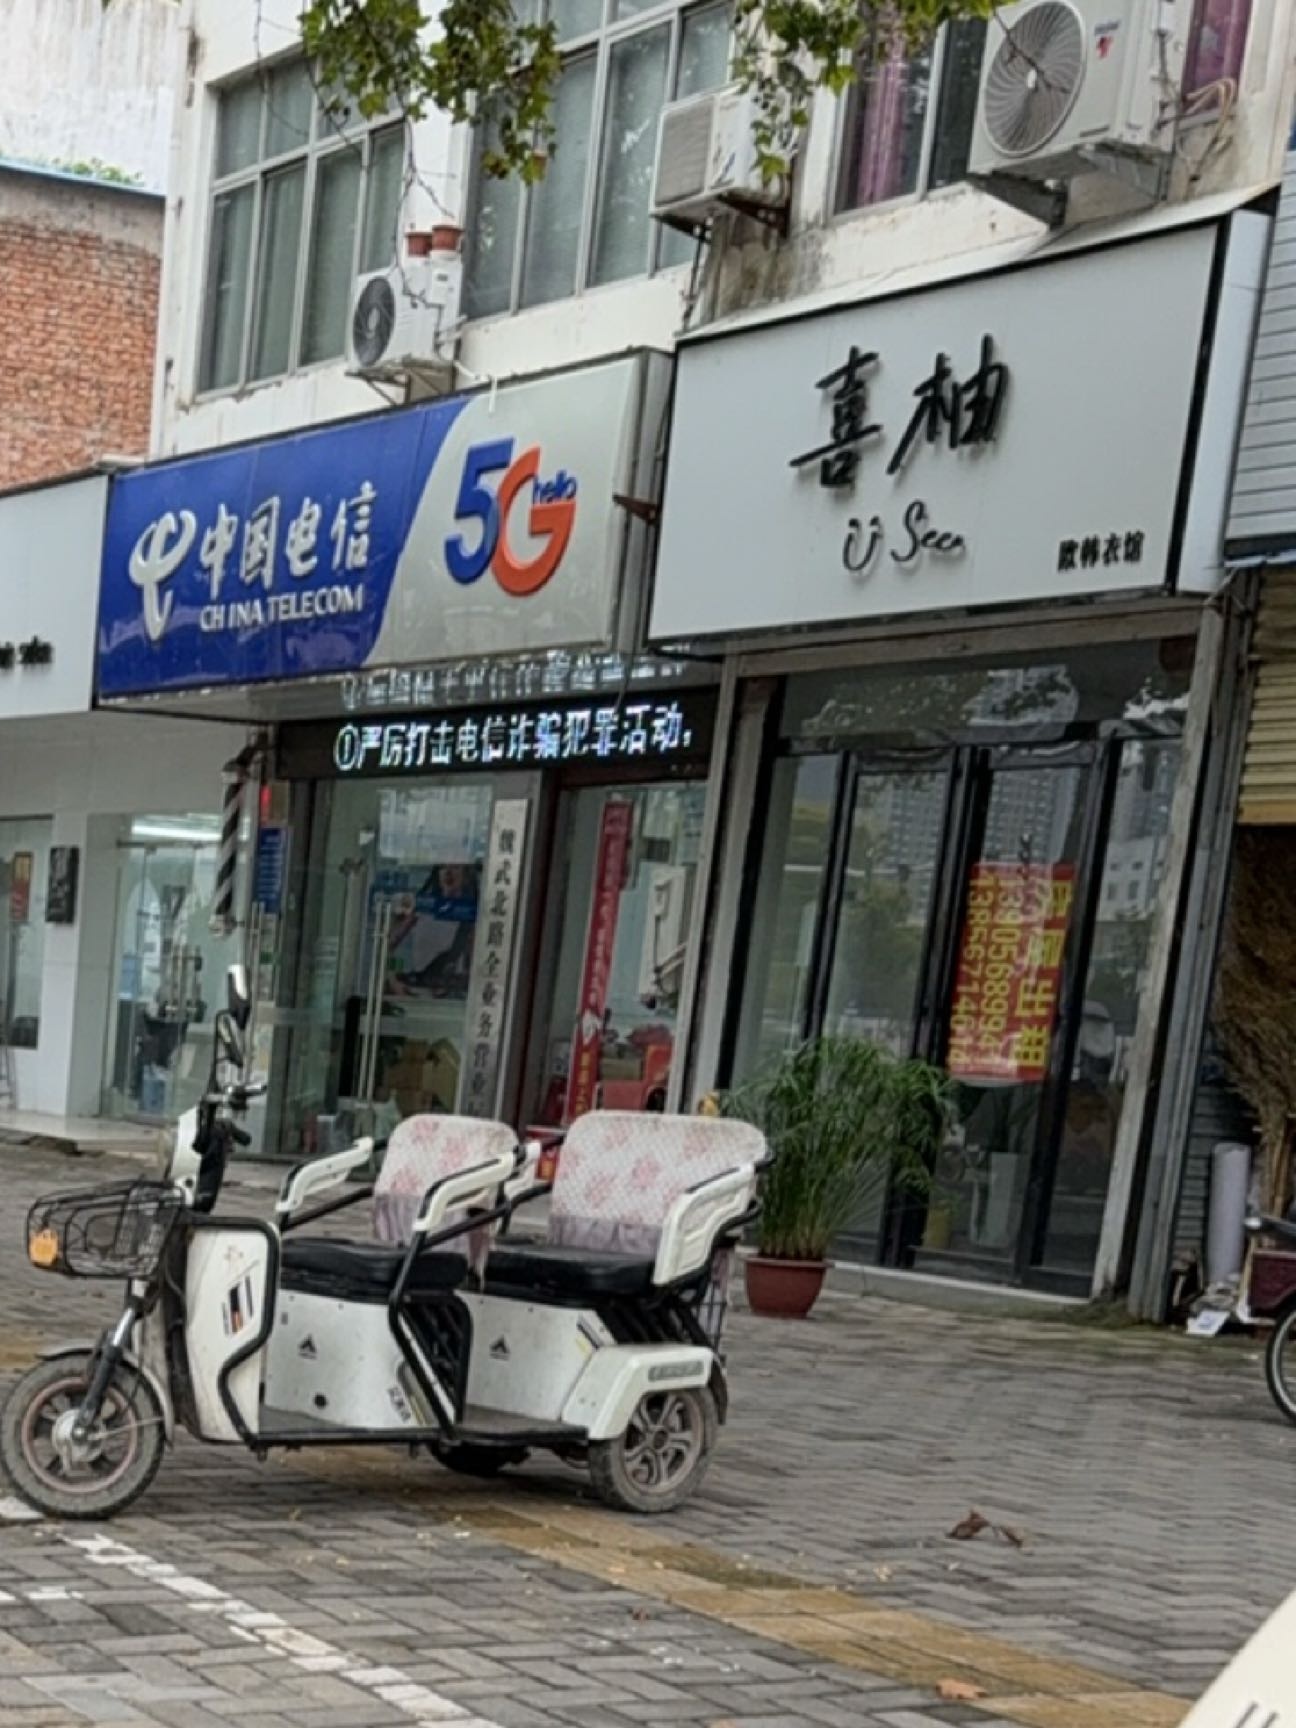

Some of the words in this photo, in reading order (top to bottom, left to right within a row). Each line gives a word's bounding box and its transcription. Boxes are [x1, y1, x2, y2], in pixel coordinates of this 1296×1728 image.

[789, 332, 1012, 489] 喜柚
[200, 481, 377, 598] 中国电信
[444, 438, 577, 597] 5G
[533, 469, 578, 505] hello
[200, 600, 264, 633] CHINA
[266, 583, 365, 623] TELECOM
